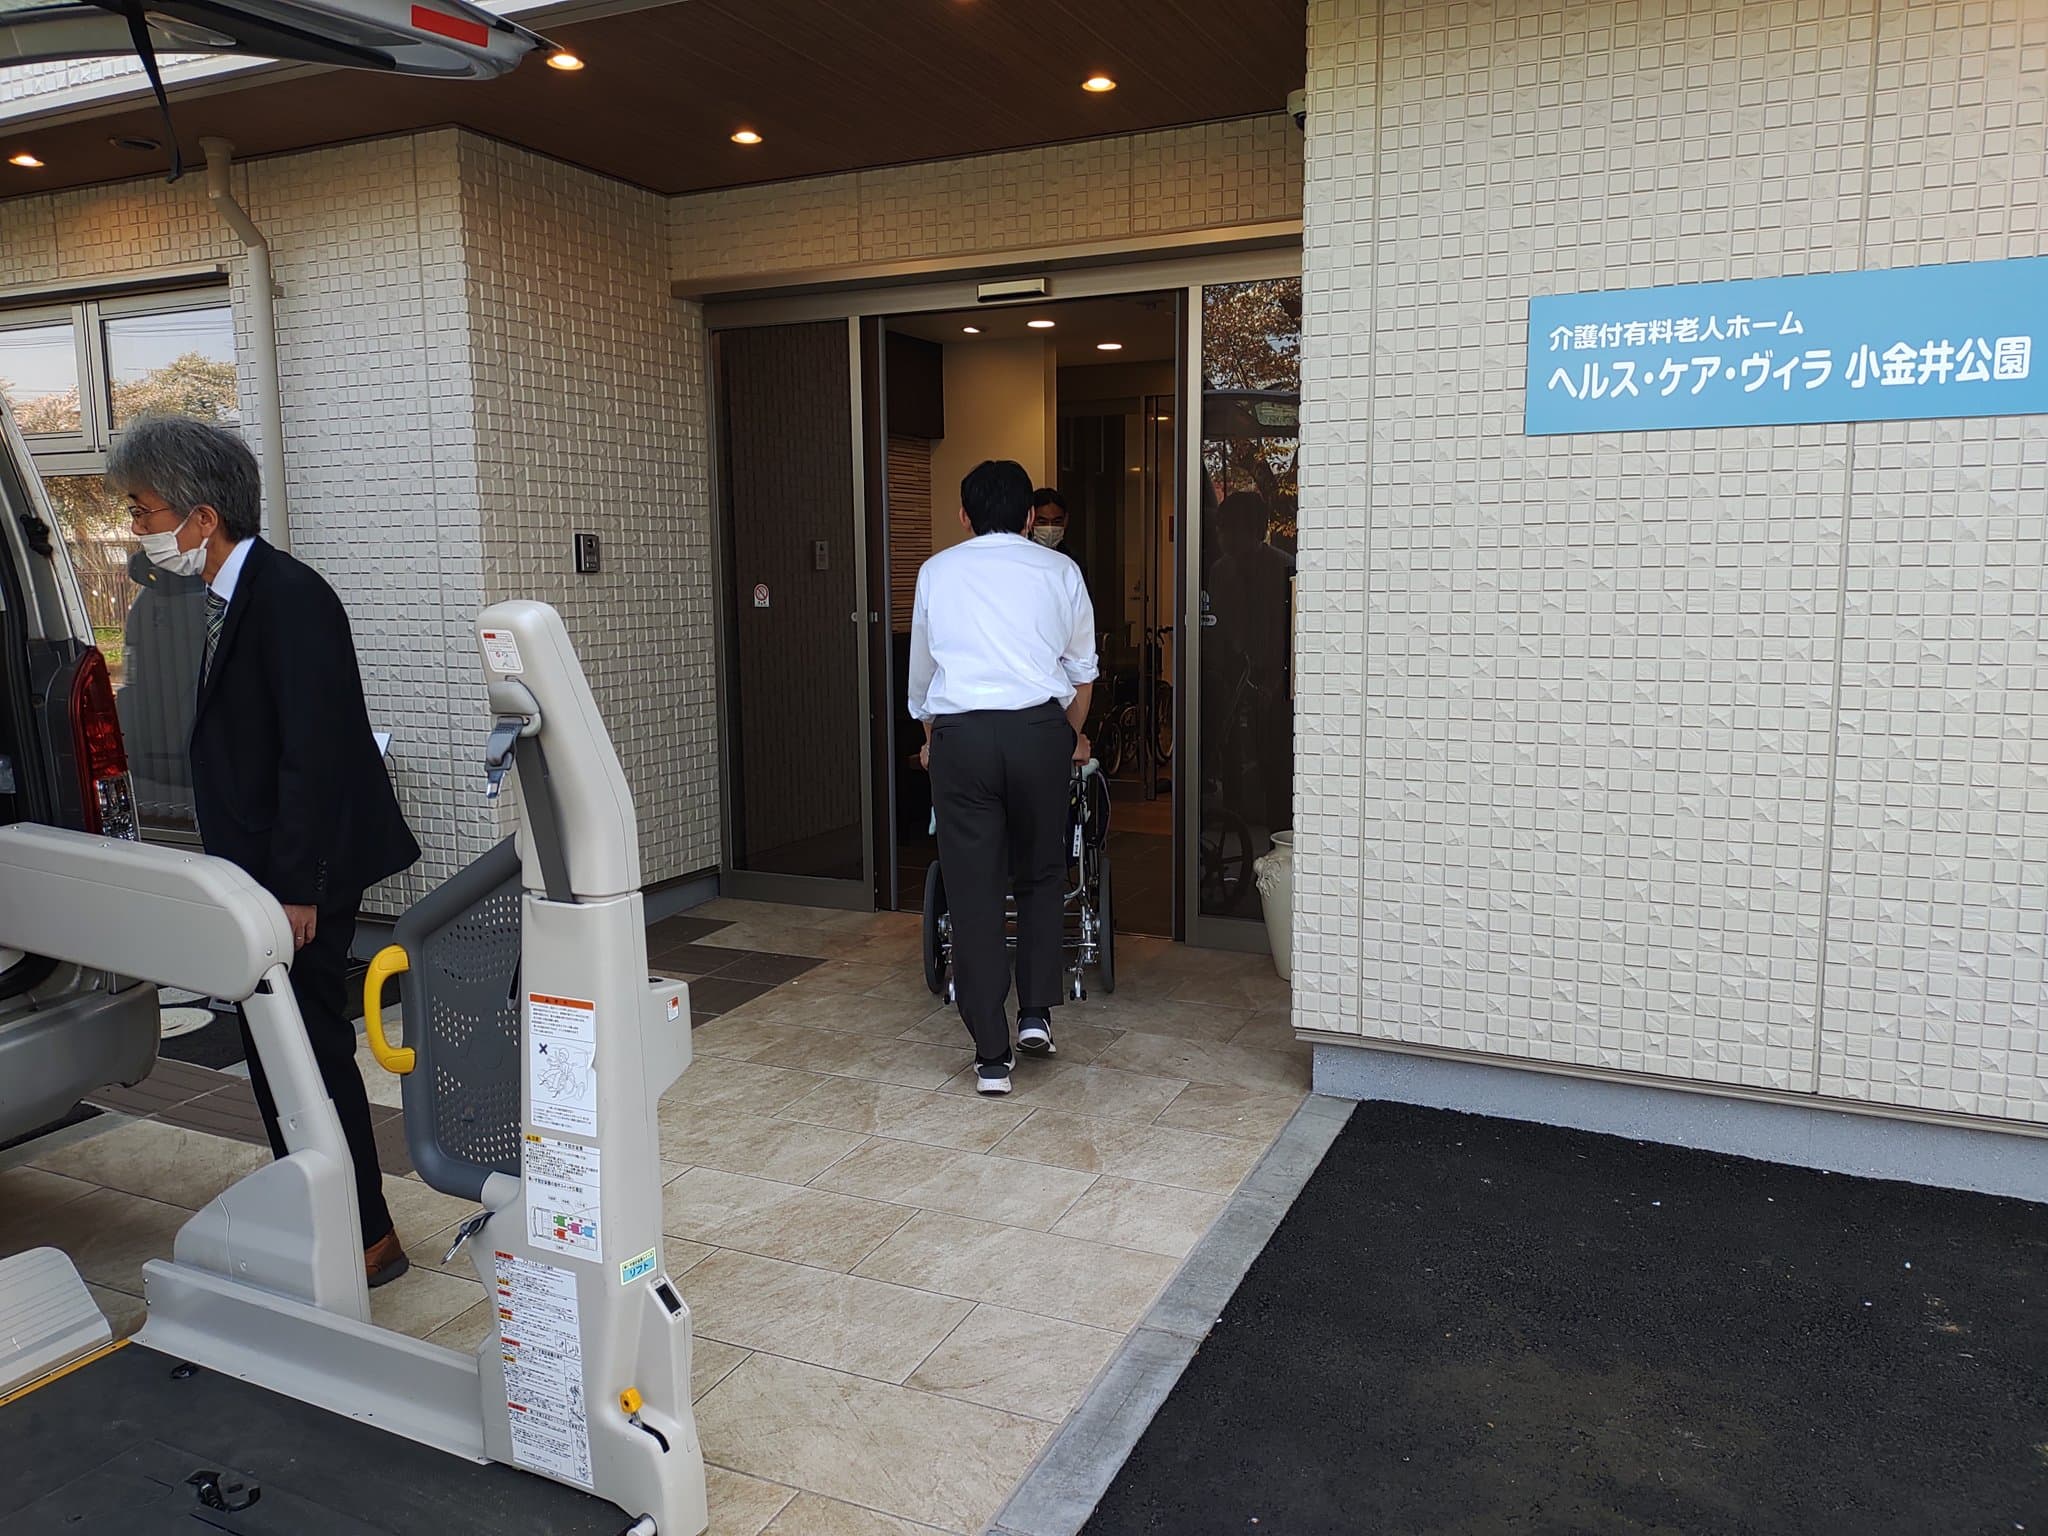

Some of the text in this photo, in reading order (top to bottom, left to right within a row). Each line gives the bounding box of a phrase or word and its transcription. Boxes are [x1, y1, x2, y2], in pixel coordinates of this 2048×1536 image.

[1549, 311, 1804, 352] 介護付有料老人ホーム
[1548, 335, 2032, 400] ヘルス・ケア・ヴィラ 小金井公園
[629, 1262, 649, 1277] リフト
